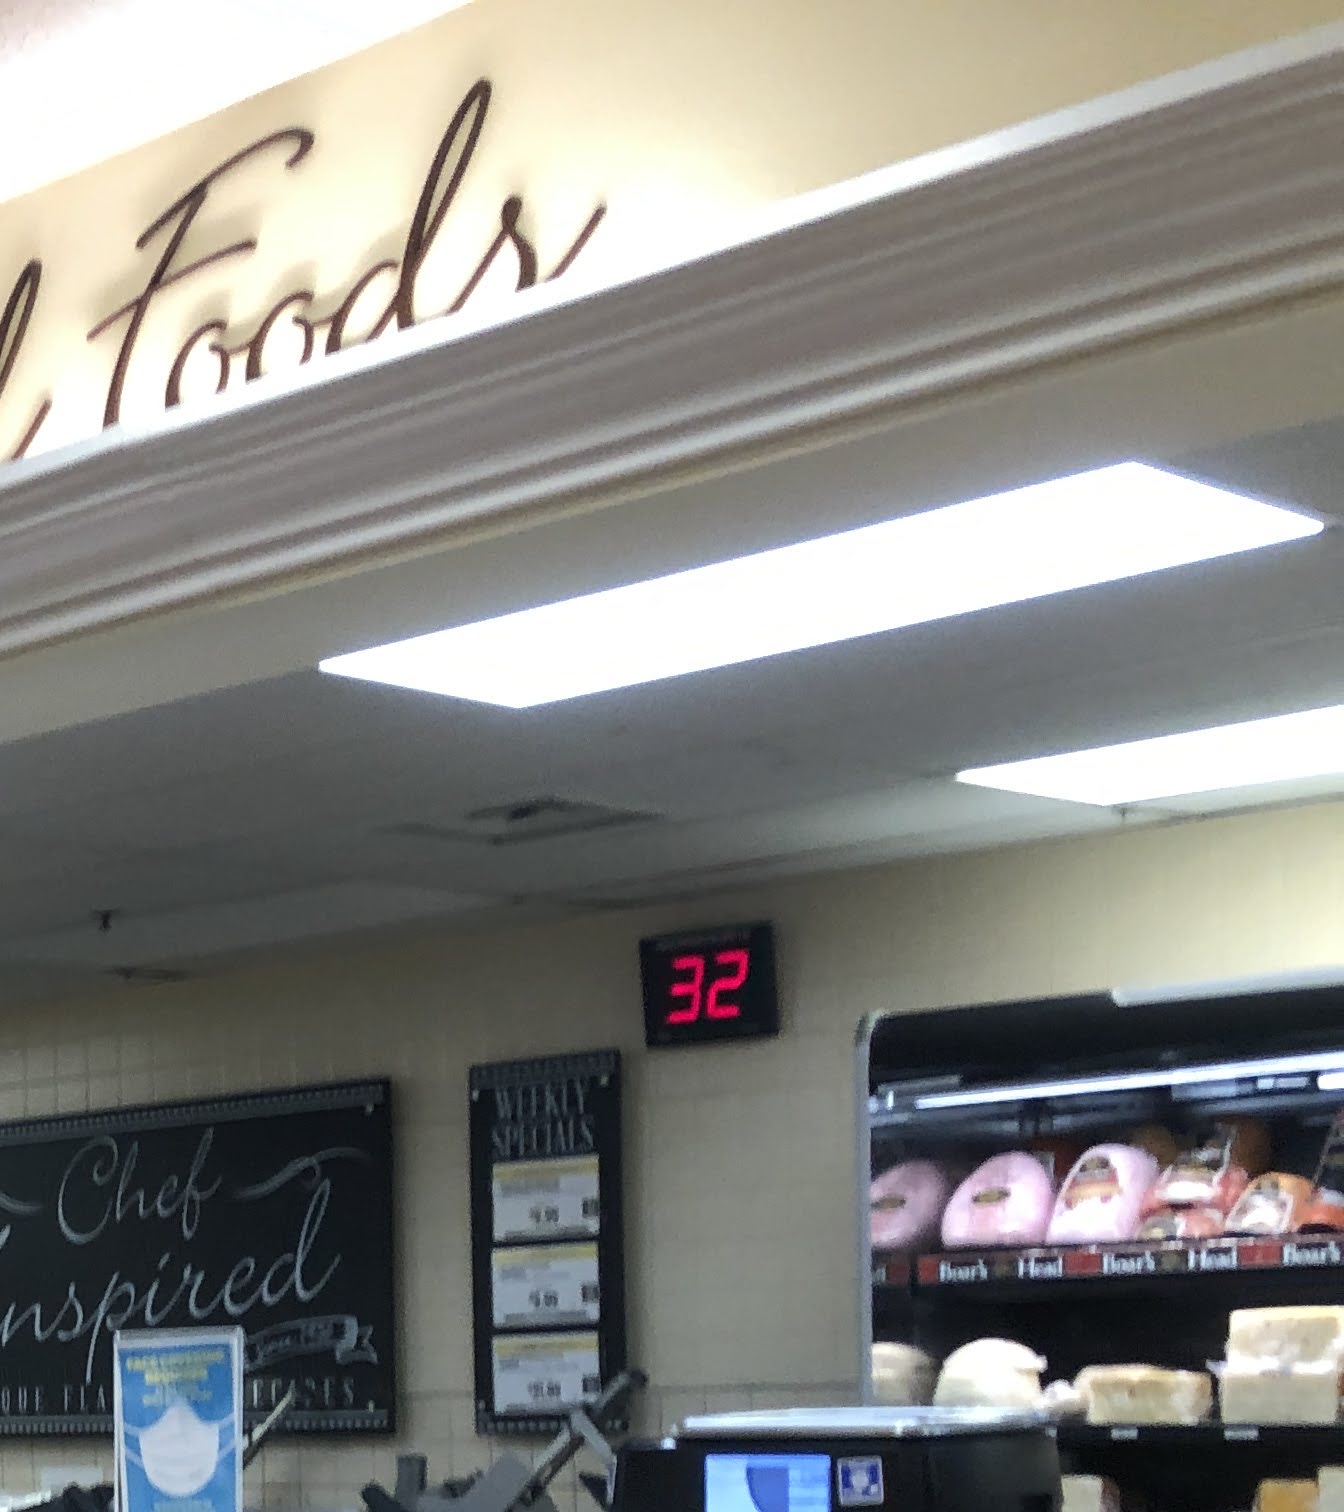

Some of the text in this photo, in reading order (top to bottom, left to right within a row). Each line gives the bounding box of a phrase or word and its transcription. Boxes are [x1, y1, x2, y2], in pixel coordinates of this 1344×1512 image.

[87, 77, 608, 428] Foods
[665, 949, 750, 1025] 32
[57, 1128, 222, 1243] Chef
